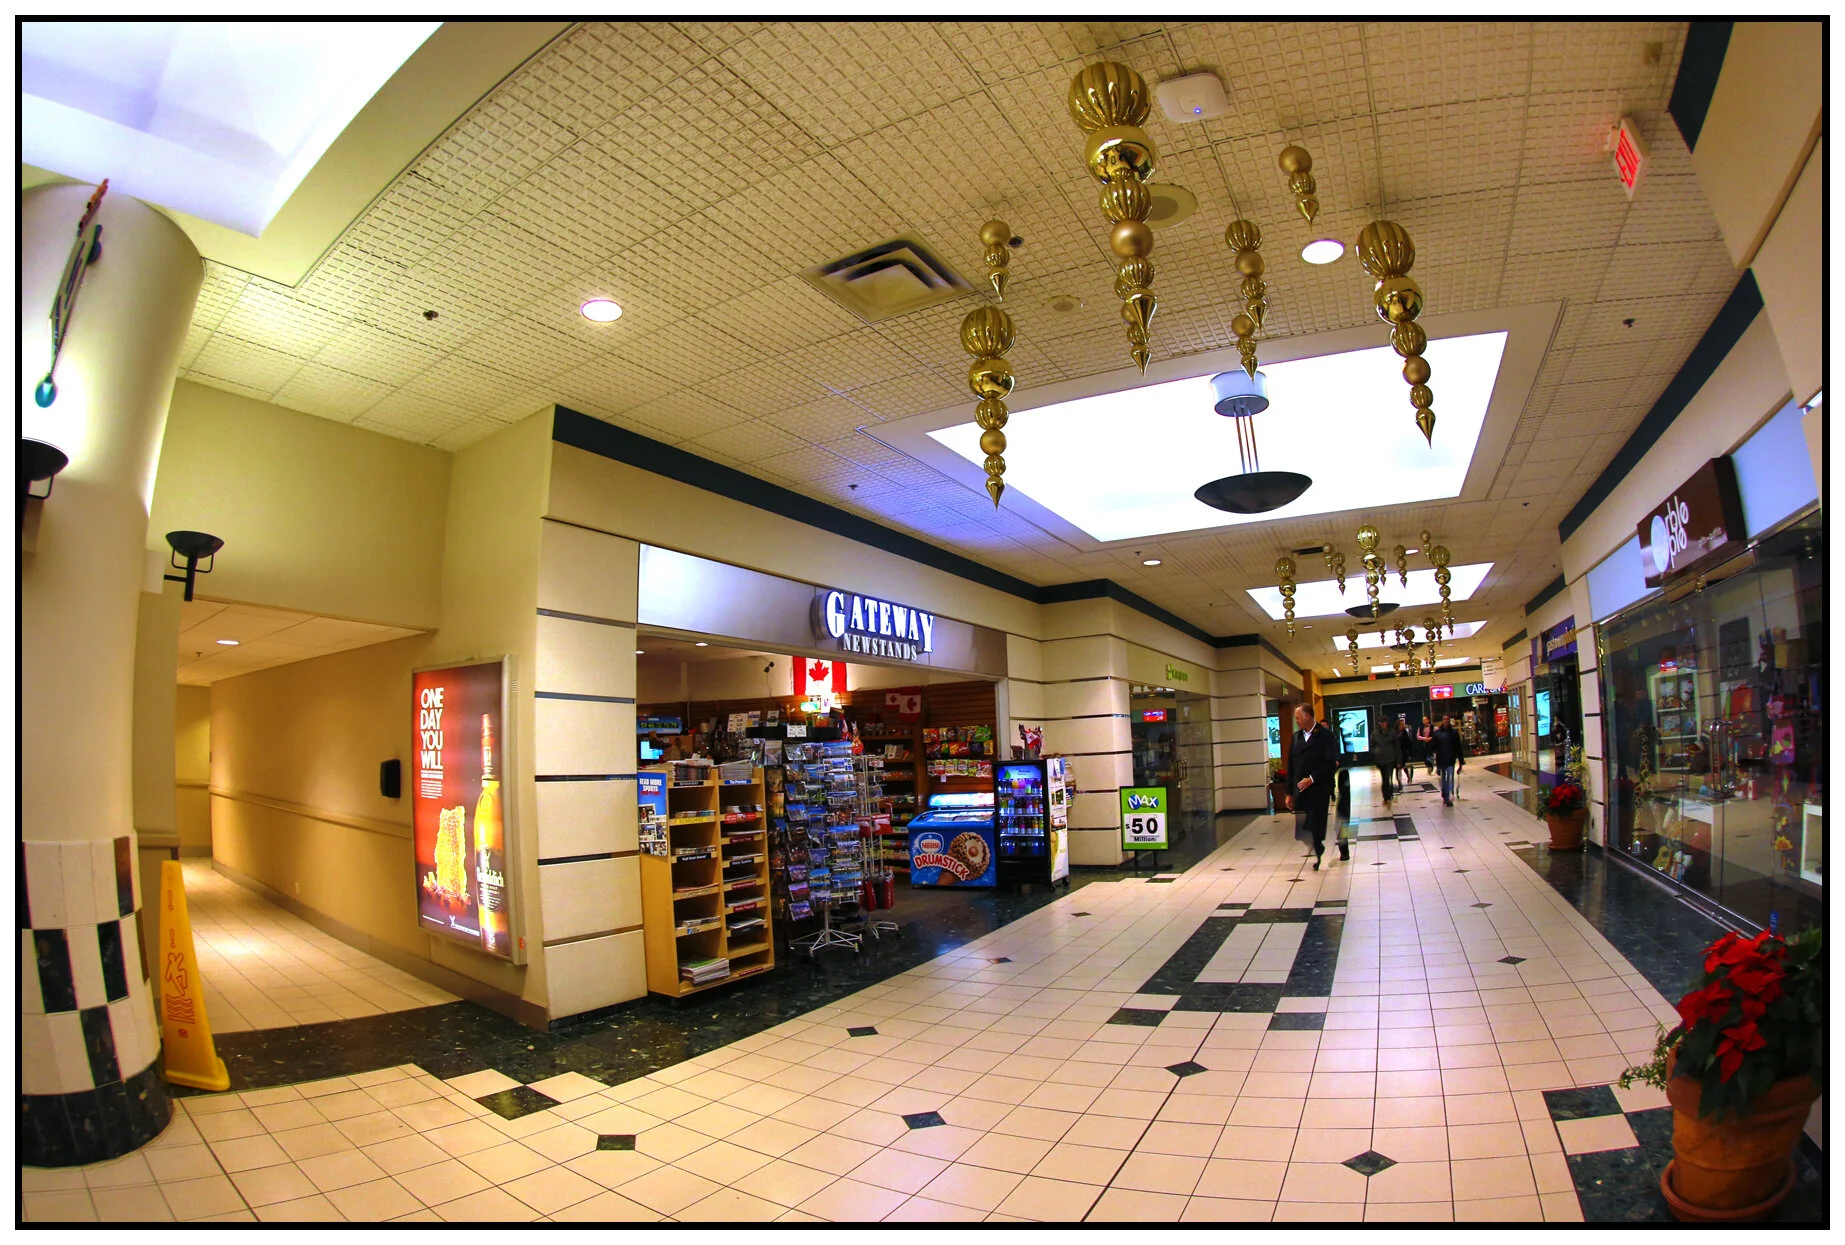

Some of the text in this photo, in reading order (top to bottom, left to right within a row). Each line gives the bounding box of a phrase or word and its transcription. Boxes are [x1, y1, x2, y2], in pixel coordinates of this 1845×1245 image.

[826, 591, 934, 653] GATEWAY
[843, 632, 918, 661] NEWSTANDS
[421, 687, 444, 709] ONE
[420, 708, 443, 730] DAY
[420, 730, 443, 750] YOU
[420, 750, 444, 770] WILL
[1128, 794, 1158, 809] MAX
[914, 853, 969, 881] DRUMSTICK
